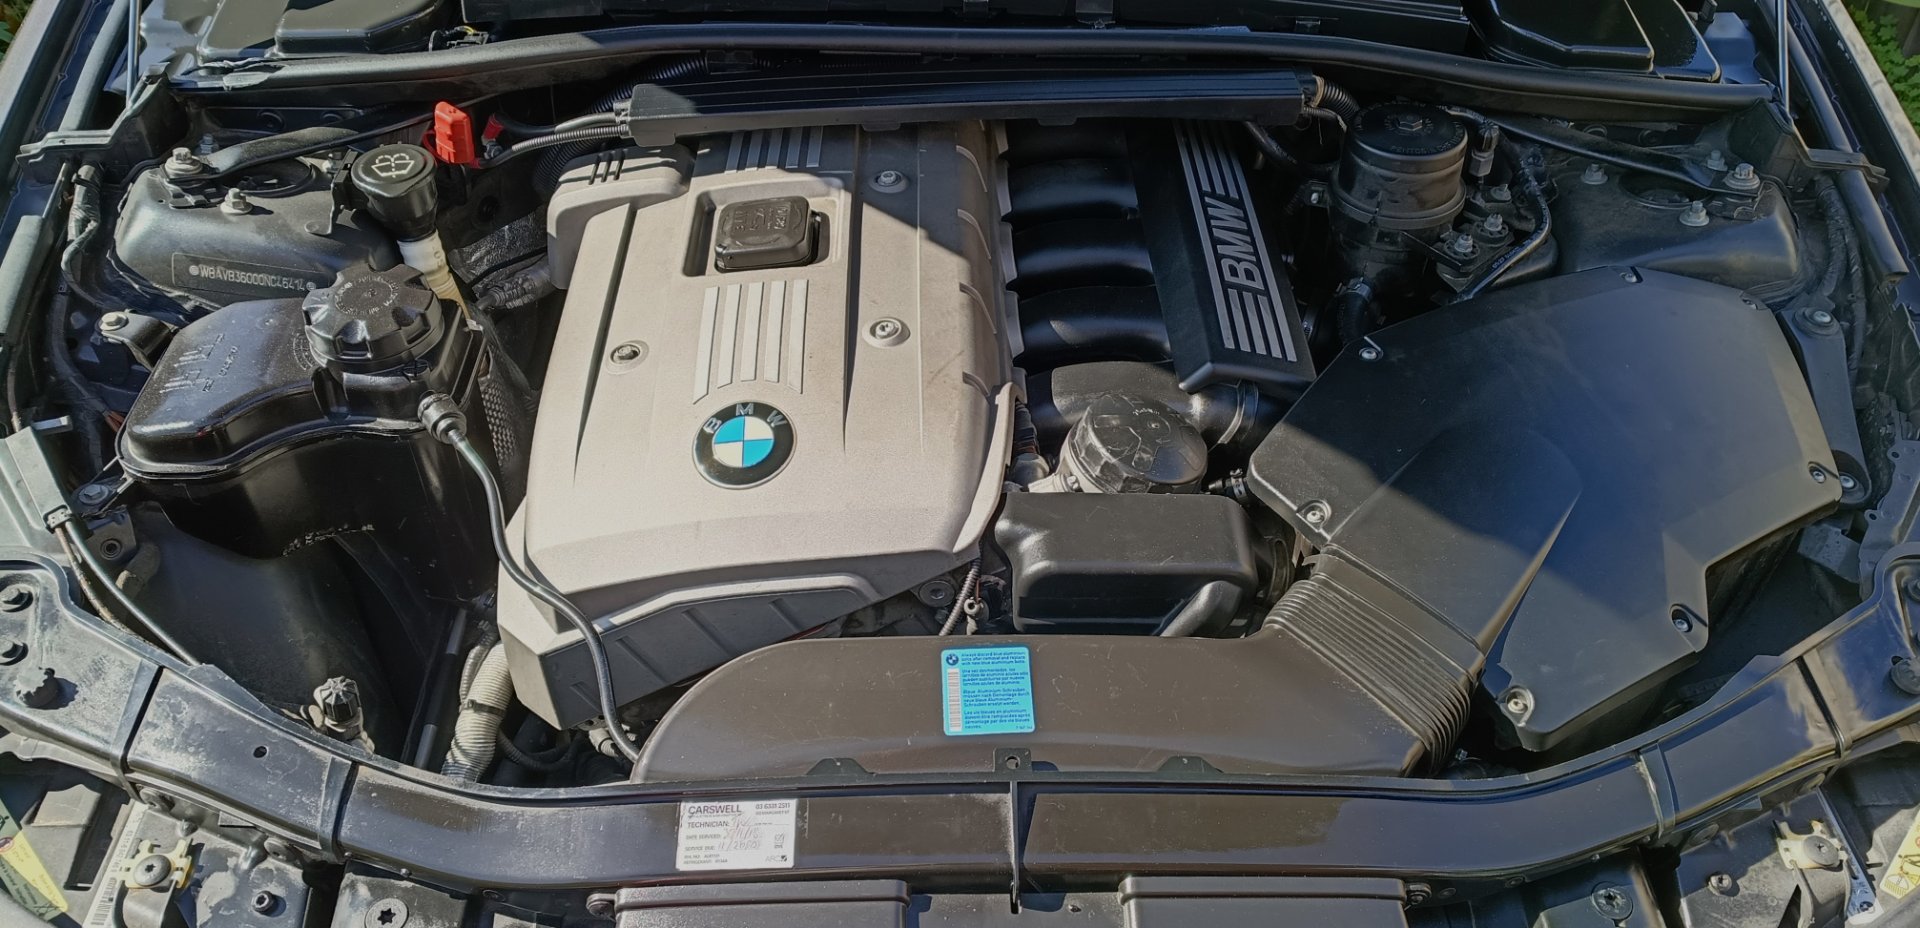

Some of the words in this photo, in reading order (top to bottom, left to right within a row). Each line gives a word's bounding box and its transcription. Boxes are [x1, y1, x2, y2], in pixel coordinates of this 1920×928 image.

[1204, 196, 1265, 290] BMW
[703, 403, 787, 433] BMW
[688, 804, 742, 814] CARSWELL
